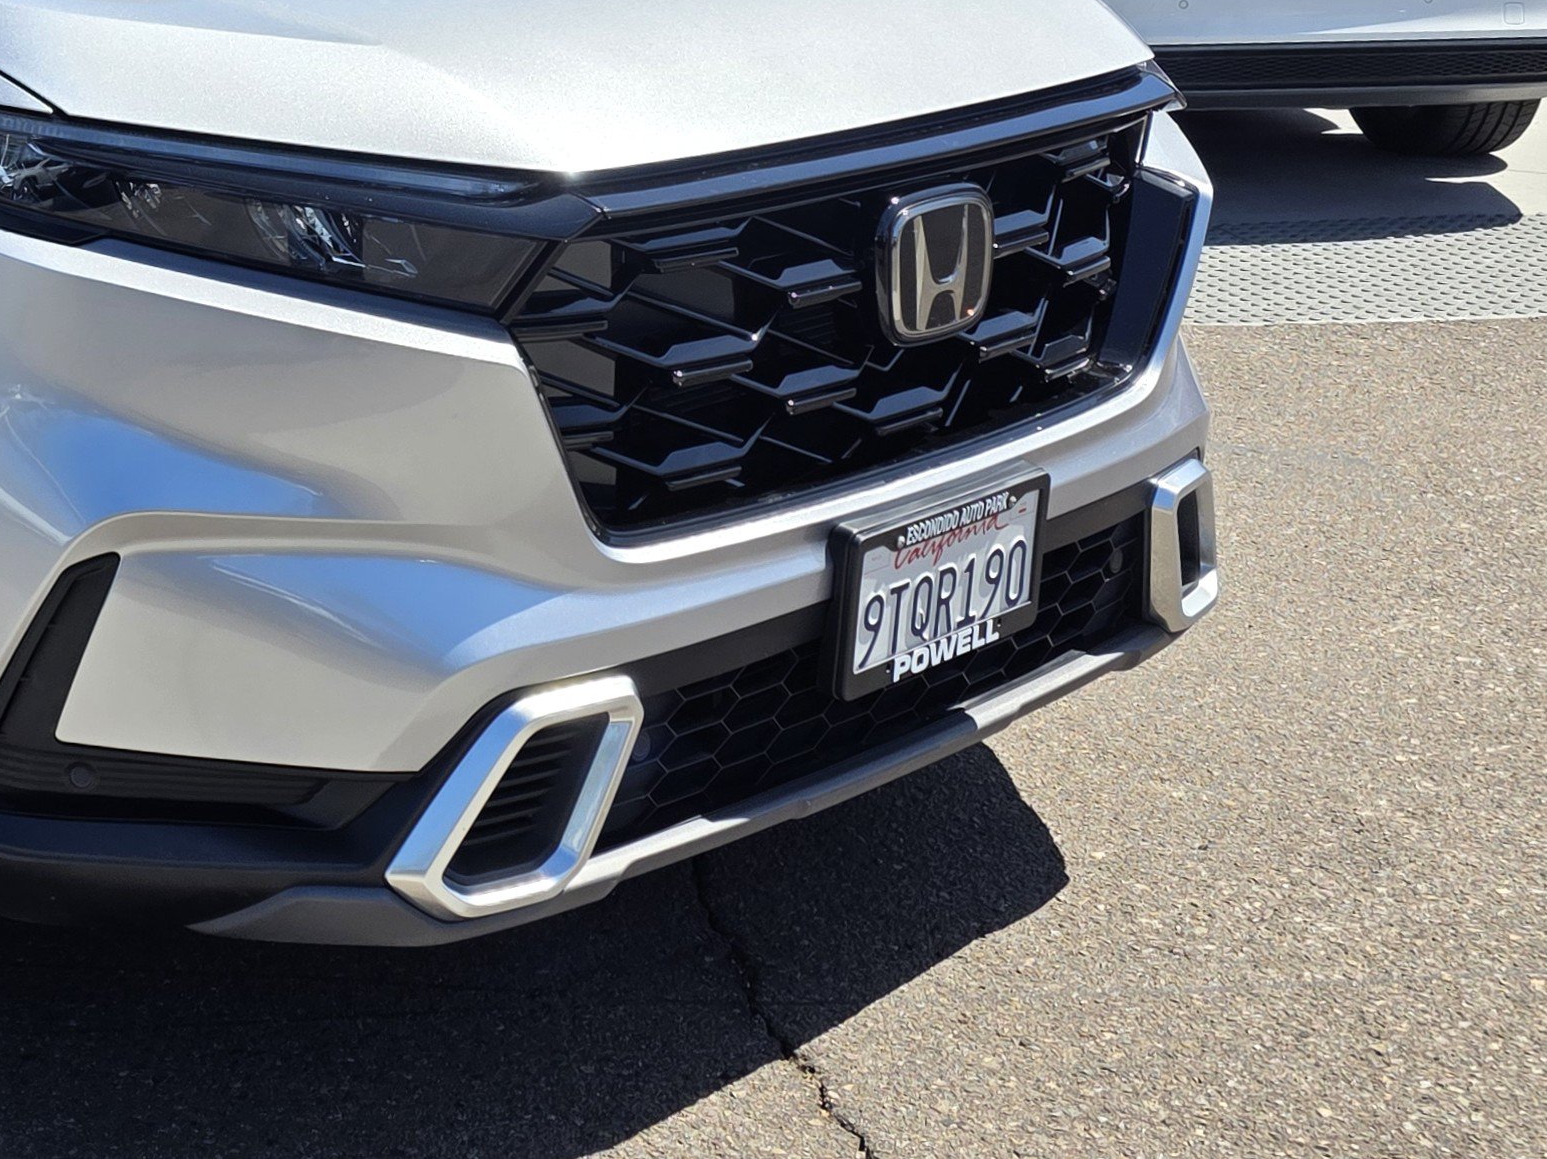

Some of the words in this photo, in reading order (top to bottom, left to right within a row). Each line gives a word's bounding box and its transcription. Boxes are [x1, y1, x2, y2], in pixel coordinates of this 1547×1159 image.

[894, 513, 1009, 570] California
[906, 510, 959, 546] ESCONDIDO
[959, 500, 985, 526] AUTO
[985, 491, 1010, 517] PARK
[858, 537, 1027, 669] 9TQR190
[893, 618, 1000, 682] POWELL
